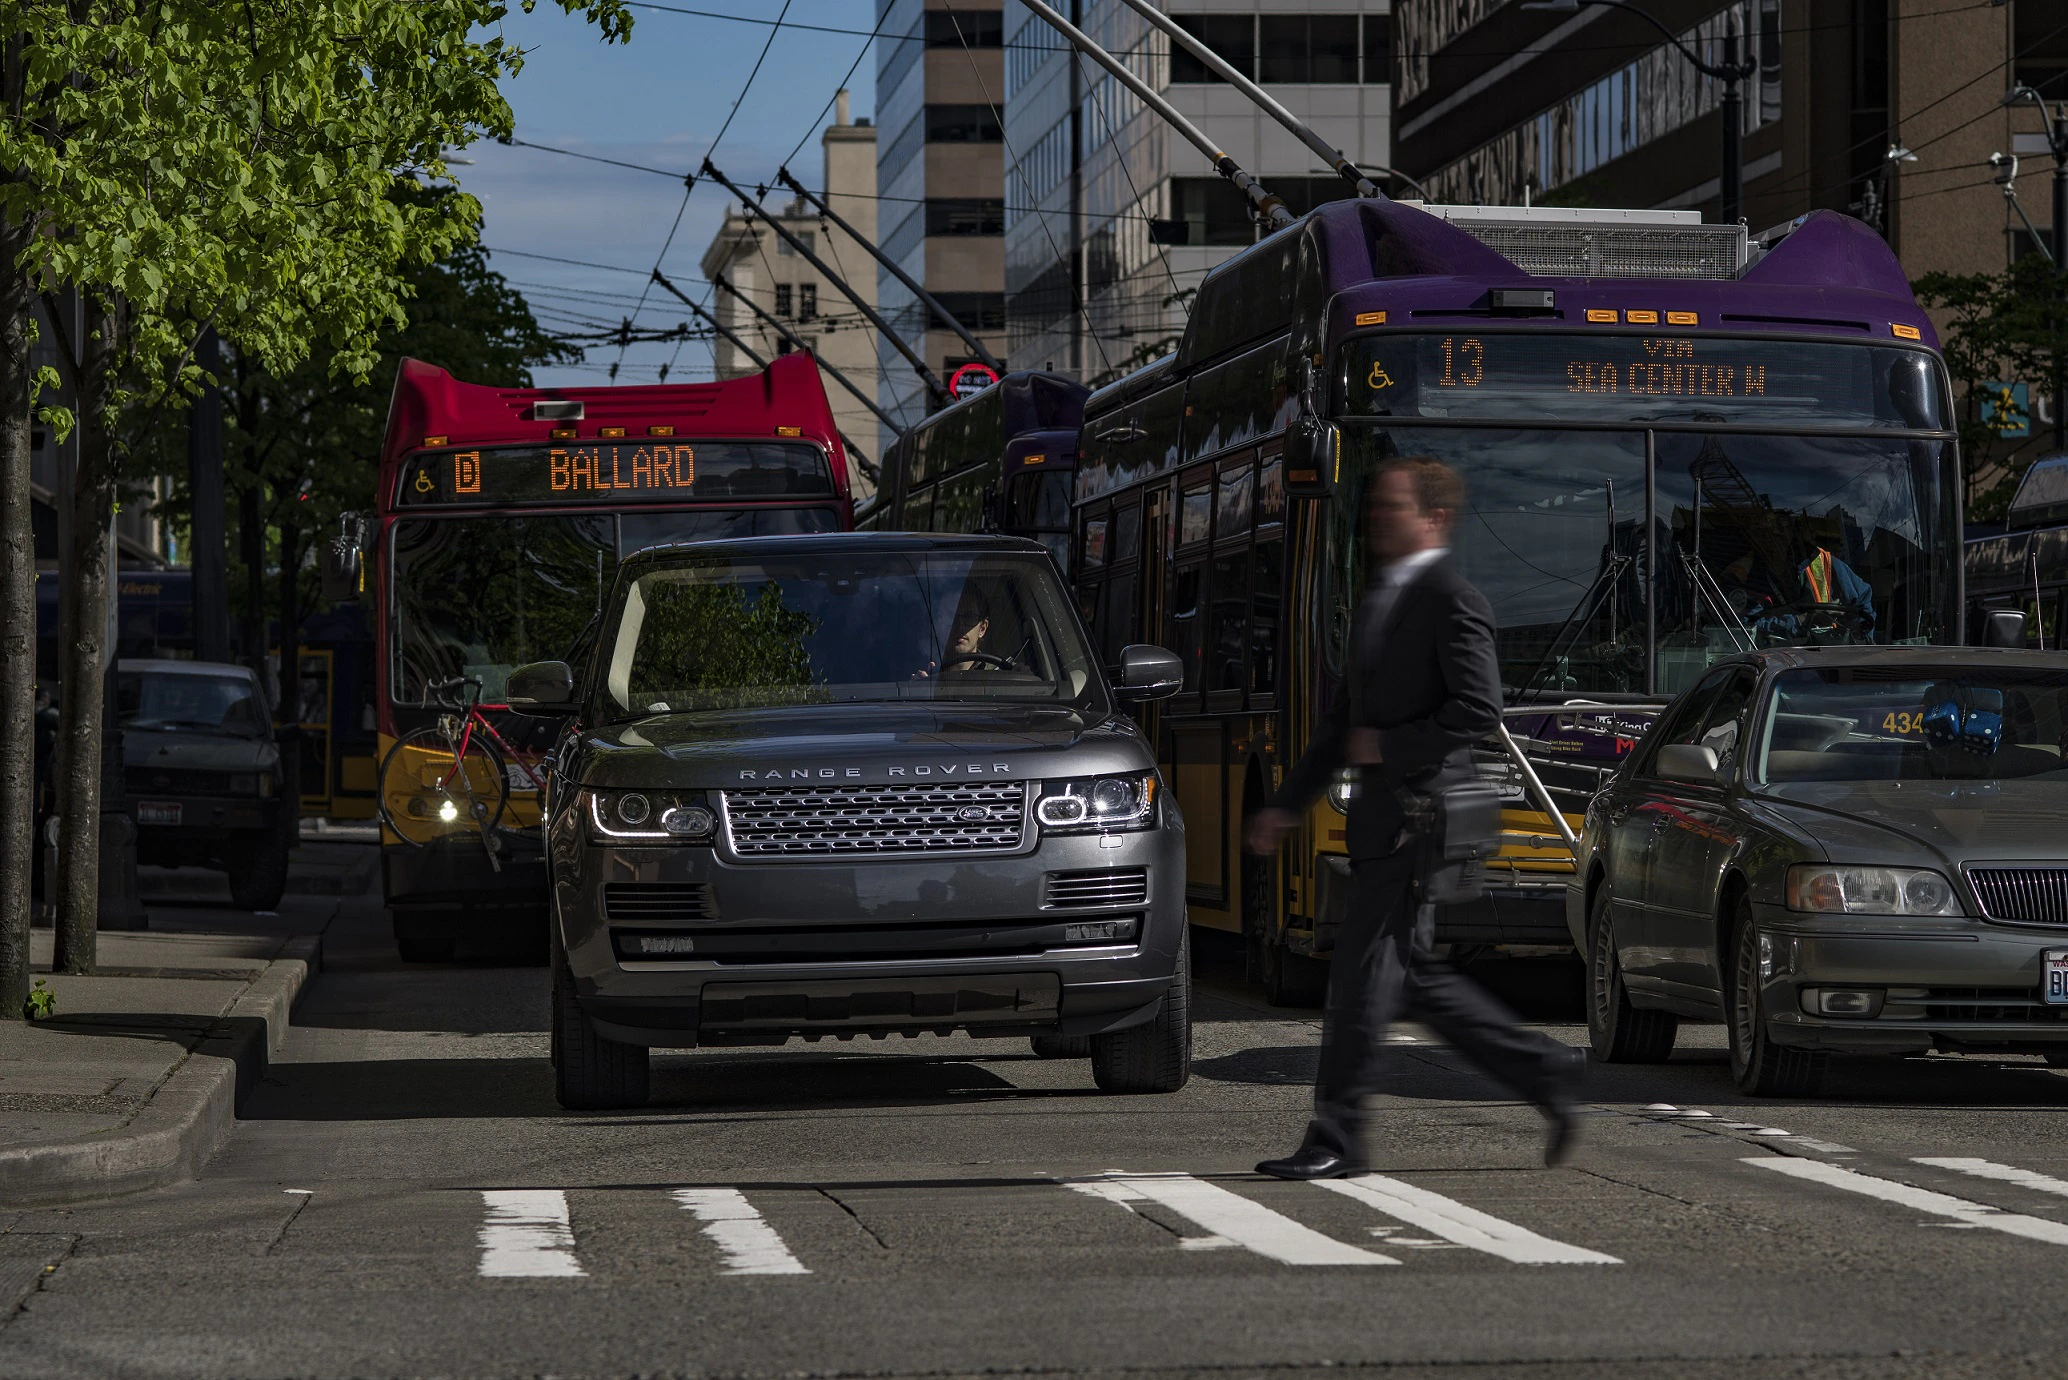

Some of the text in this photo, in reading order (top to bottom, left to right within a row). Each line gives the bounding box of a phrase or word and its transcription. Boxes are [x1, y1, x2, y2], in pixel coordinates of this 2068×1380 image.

[1440, 338, 1483, 387] 13
[1643, 339, 1694, 358] VIA
[1567, 361, 1766, 396] SEA CENTER W
[550, 445, 695, 491] BALLARD
[739, 762, 1010, 780] RANGE ROVER
